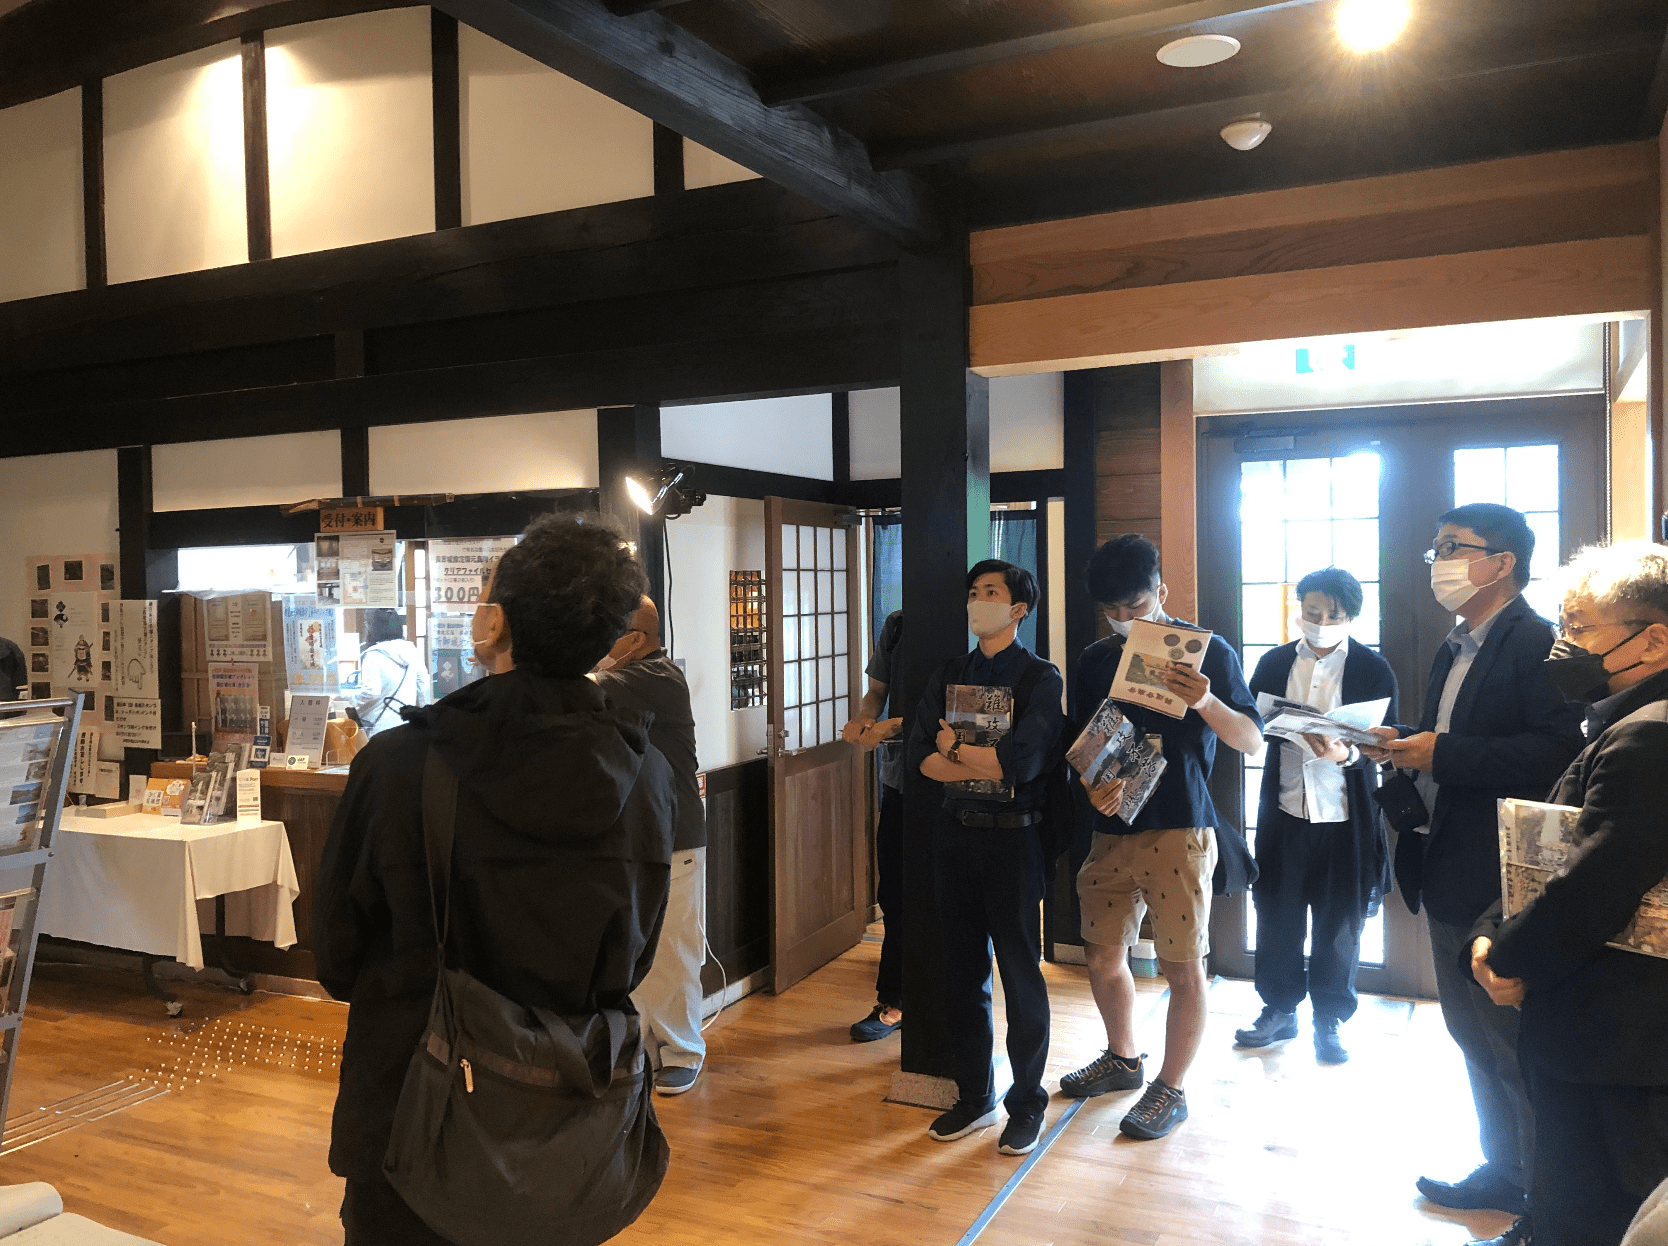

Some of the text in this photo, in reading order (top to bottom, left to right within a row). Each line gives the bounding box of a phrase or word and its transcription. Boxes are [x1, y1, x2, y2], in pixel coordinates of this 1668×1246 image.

[321, 511, 376, 529] 受付・案内
[434, 586, 480, 602] 300円
